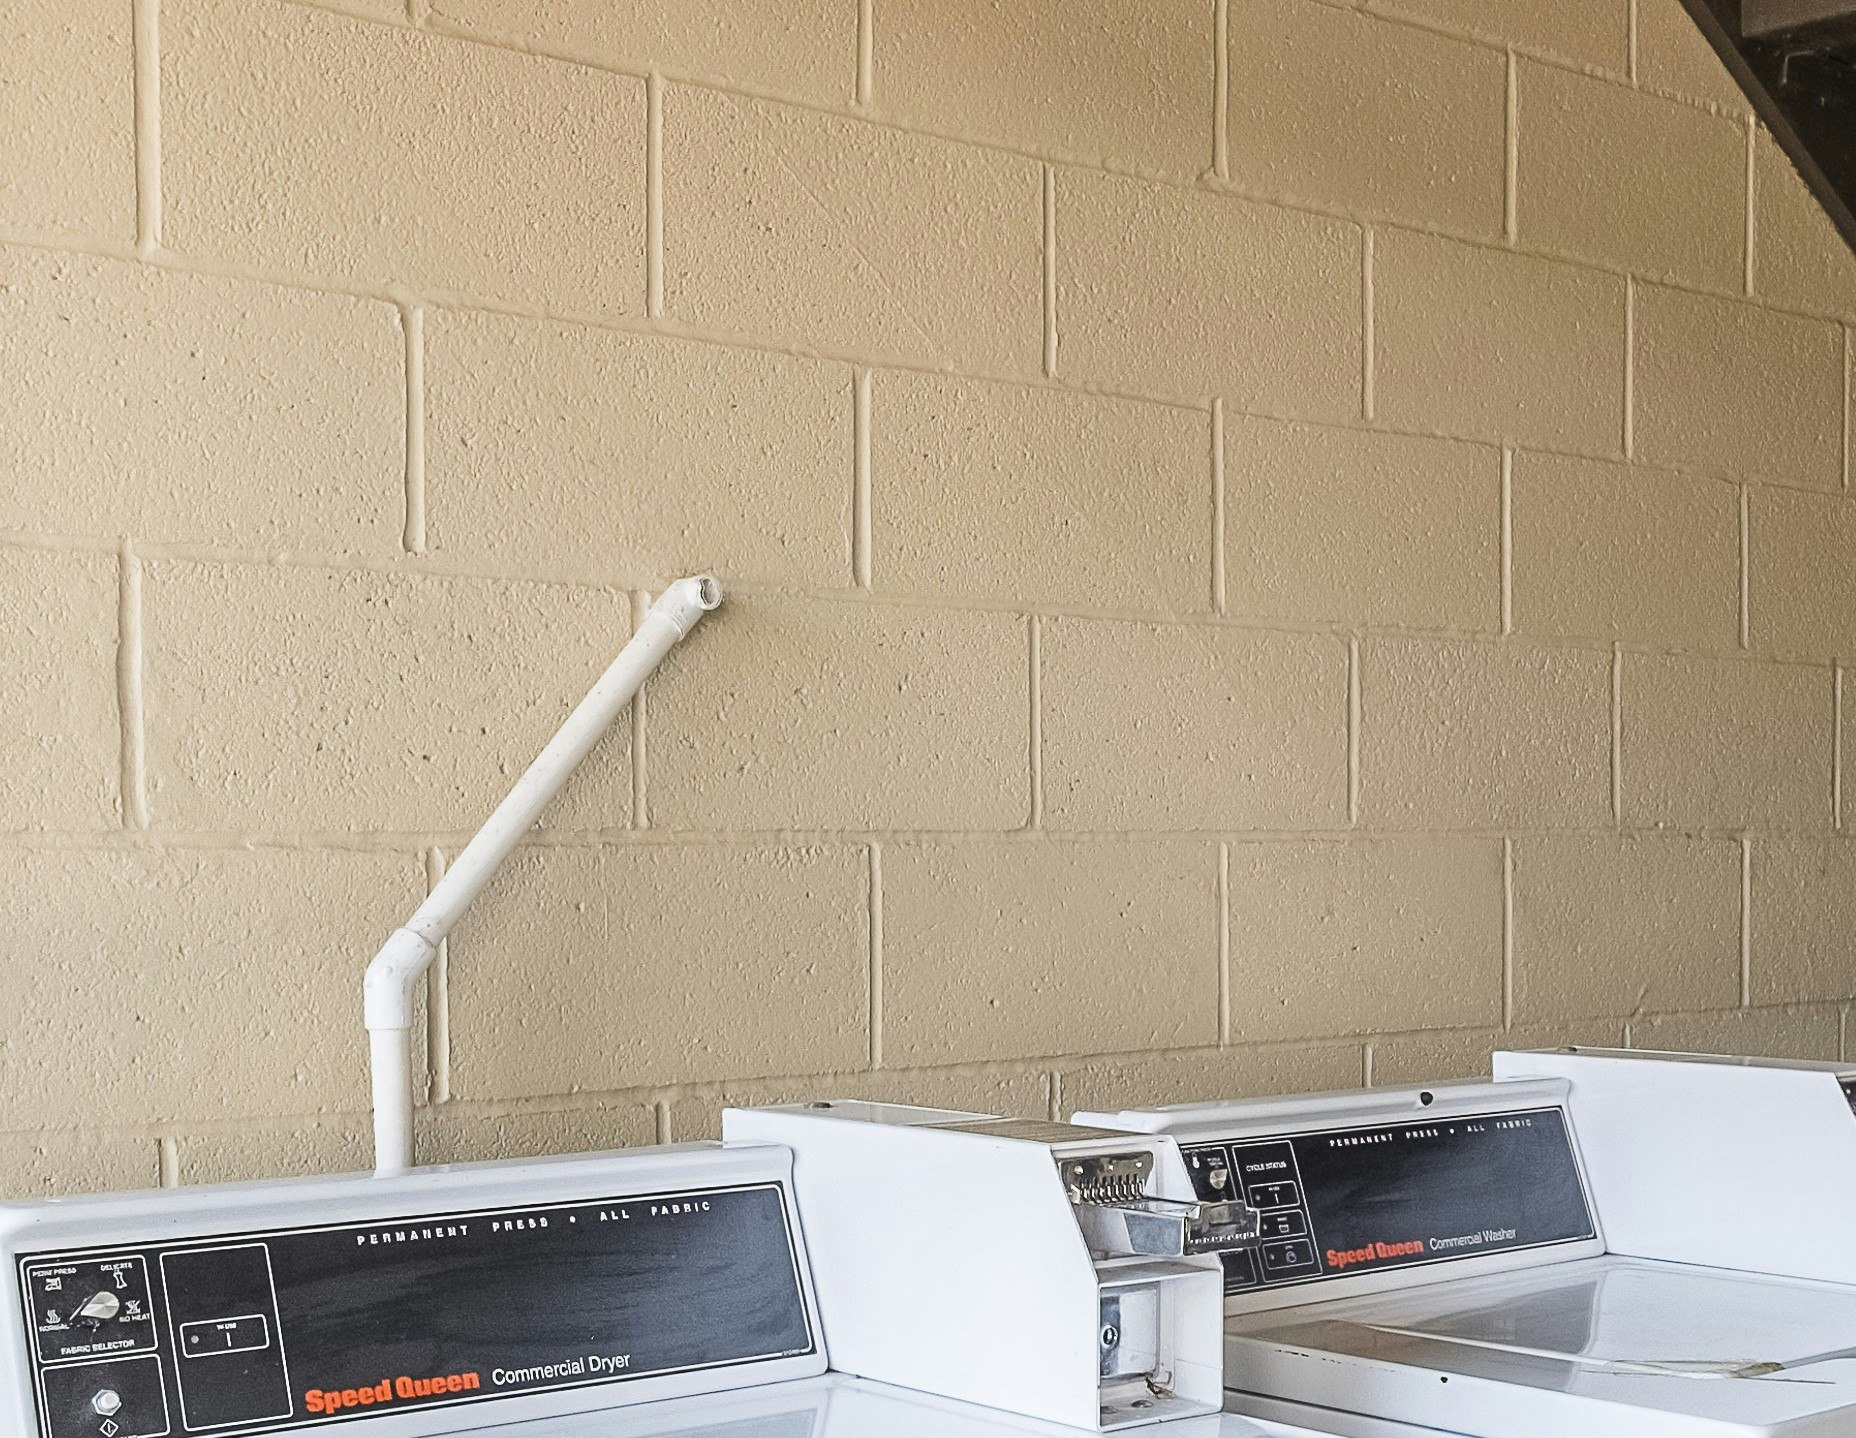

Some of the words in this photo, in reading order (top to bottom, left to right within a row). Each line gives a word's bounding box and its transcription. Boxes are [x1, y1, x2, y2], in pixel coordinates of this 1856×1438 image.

[1329, 1133, 1394, 1147] PERMANENT
[1405, 1128, 1439, 1140] PRESS
[1466, 1123, 1486, 1133] ALL
[1496, 1118, 1533, 1130] FABRIC
[357, 1225, 469, 1247] PERMANENT
[491, 1217, 549, 1233] PRESS
[600, 1209, 631, 1222] ALL
[650, 1200, 712, 1217] FABRIC
[1326, 1242, 1376, 1268] Speed
[1376, 1239, 1424, 1258] Queen
[1429, 1231, 1483, 1251] Commercial
[1482, 1227, 1517, 1243] Washer
[61, 1344, 91, 1355] FABRIC
[92, 1339, 135, 1352] SELECTOR
[305, 1379, 393, 1415] Speed
[395, 1372, 481, 1400] Queen
[492, 1358, 586, 1386] Commercial
[588, 1352, 632, 1374] Dryer
